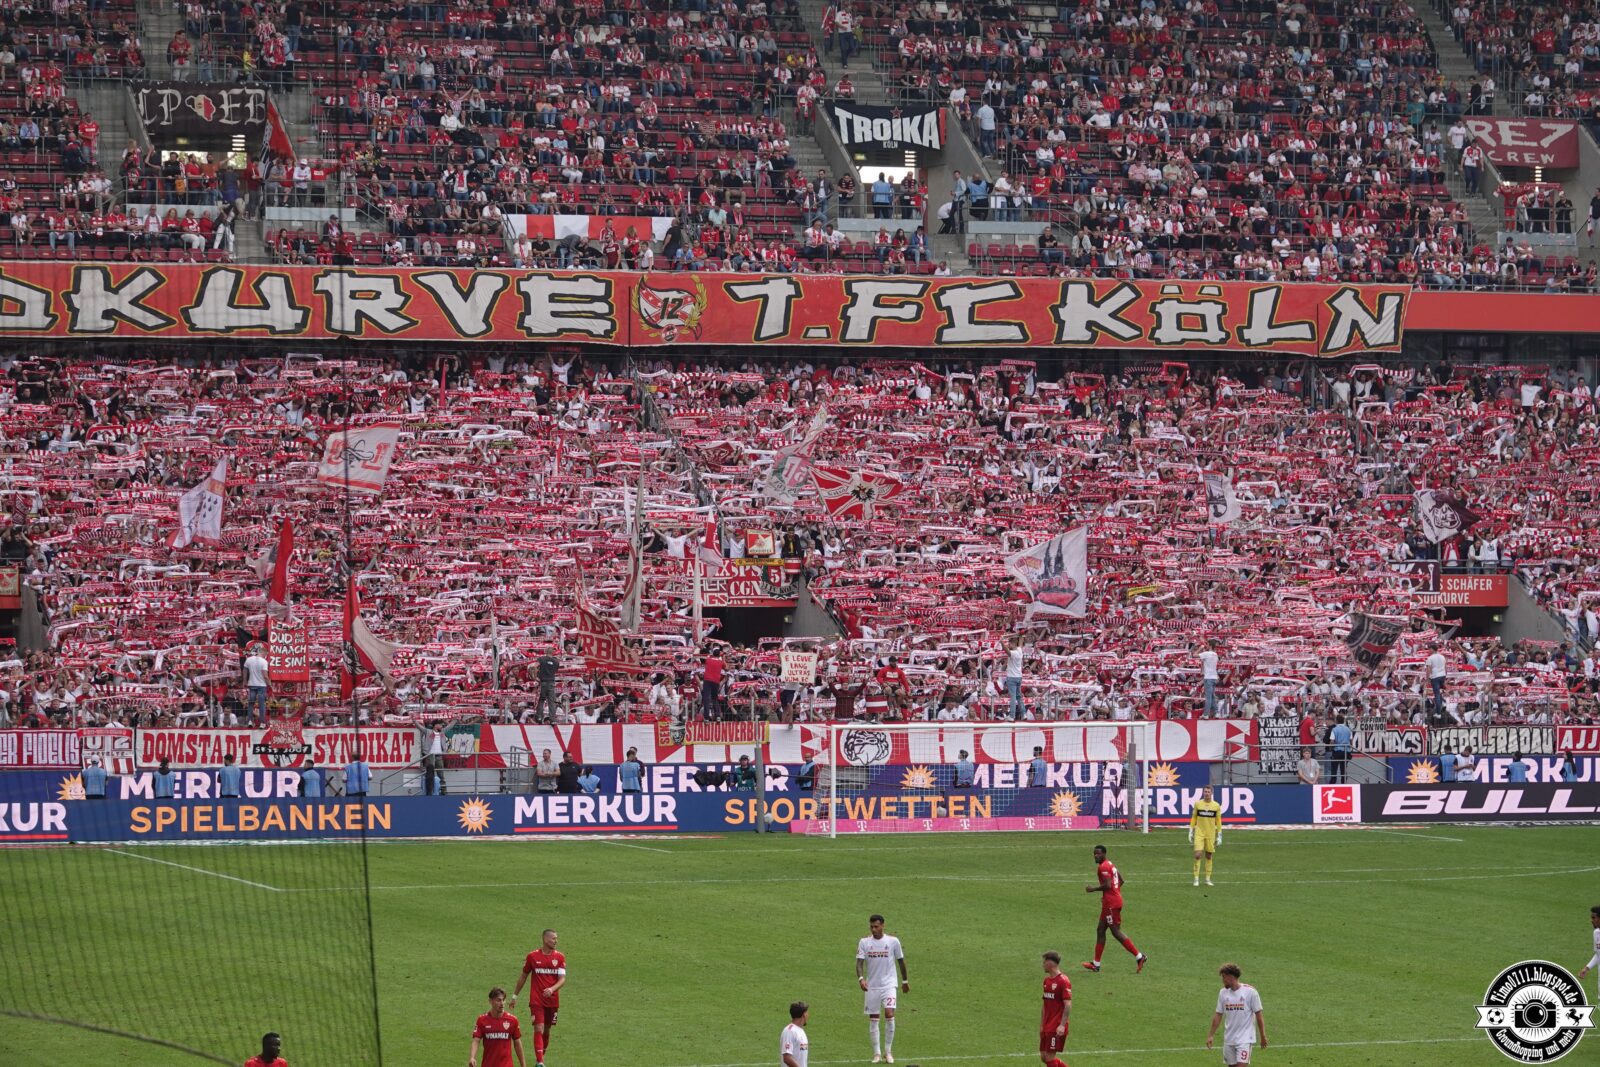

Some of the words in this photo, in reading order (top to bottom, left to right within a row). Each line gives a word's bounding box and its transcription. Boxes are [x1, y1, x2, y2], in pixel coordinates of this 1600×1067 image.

[834, 106, 941, 150] TROIKA
[1467, 120, 1575, 148] RE7
[1487, 150, 1555, 164] CREW
[660, 297, 684, 319] 12
[1049, 279, 1406, 355] KÖLN
[1447, 577, 1492, 591] SCHÄFER
[270, 656, 281, 667] ZE
[23, 733, 79, 765] FIDELIS
[143, 734, 250, 764] DOMSTADT
[314, 732, 414, 763] SYNDIKAT
[514, 796, 677, 824] MERKUR
[1382, 789, 1600, 816] BULL
[130, 803, 392, 833] SPIELBANKEN
[1240, 1050, 1248, 1060] 9
